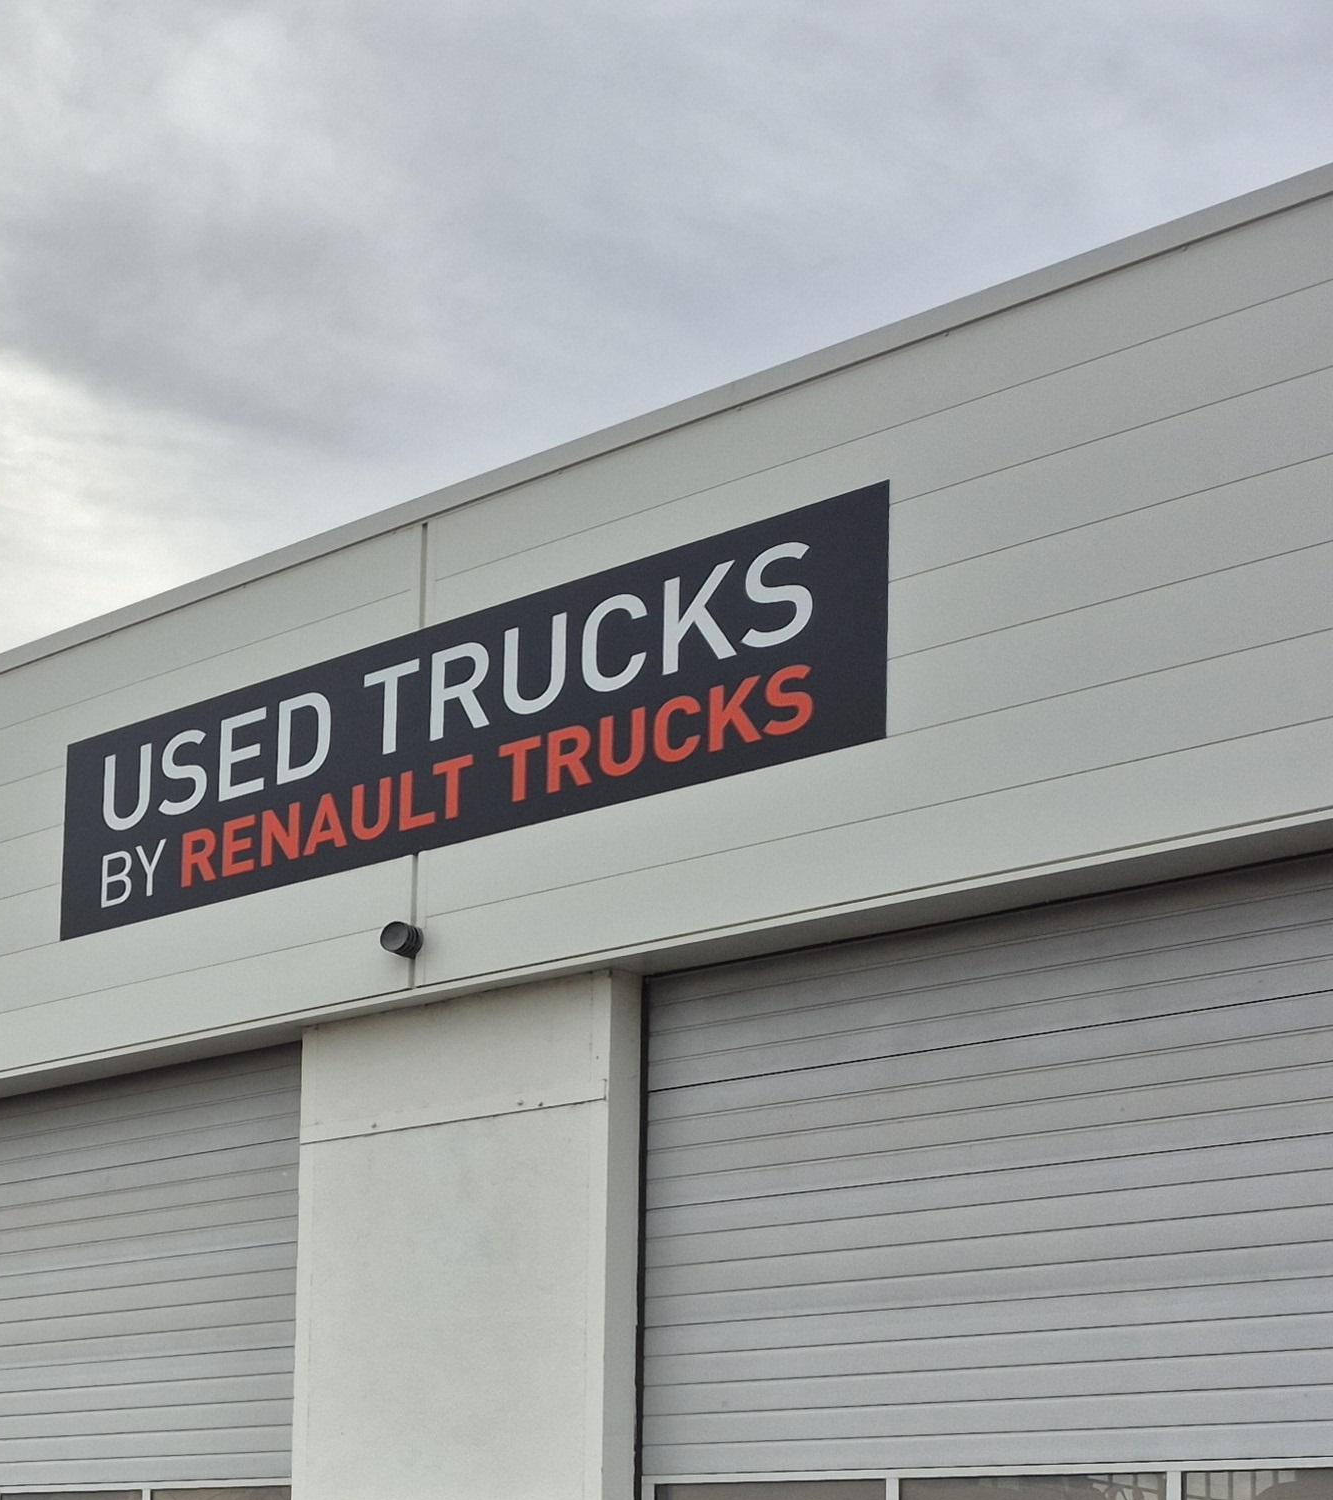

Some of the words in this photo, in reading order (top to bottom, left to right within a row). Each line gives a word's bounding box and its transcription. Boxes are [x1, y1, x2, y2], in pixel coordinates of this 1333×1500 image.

[100, 839, 167, 909] BY
[179, 754, 475, 888] RENAULT
[498, 664, 814, 802] TRUCKS
[102, 692, 332, 833] USED
[363, 541, 814, 755] TRUCKS
